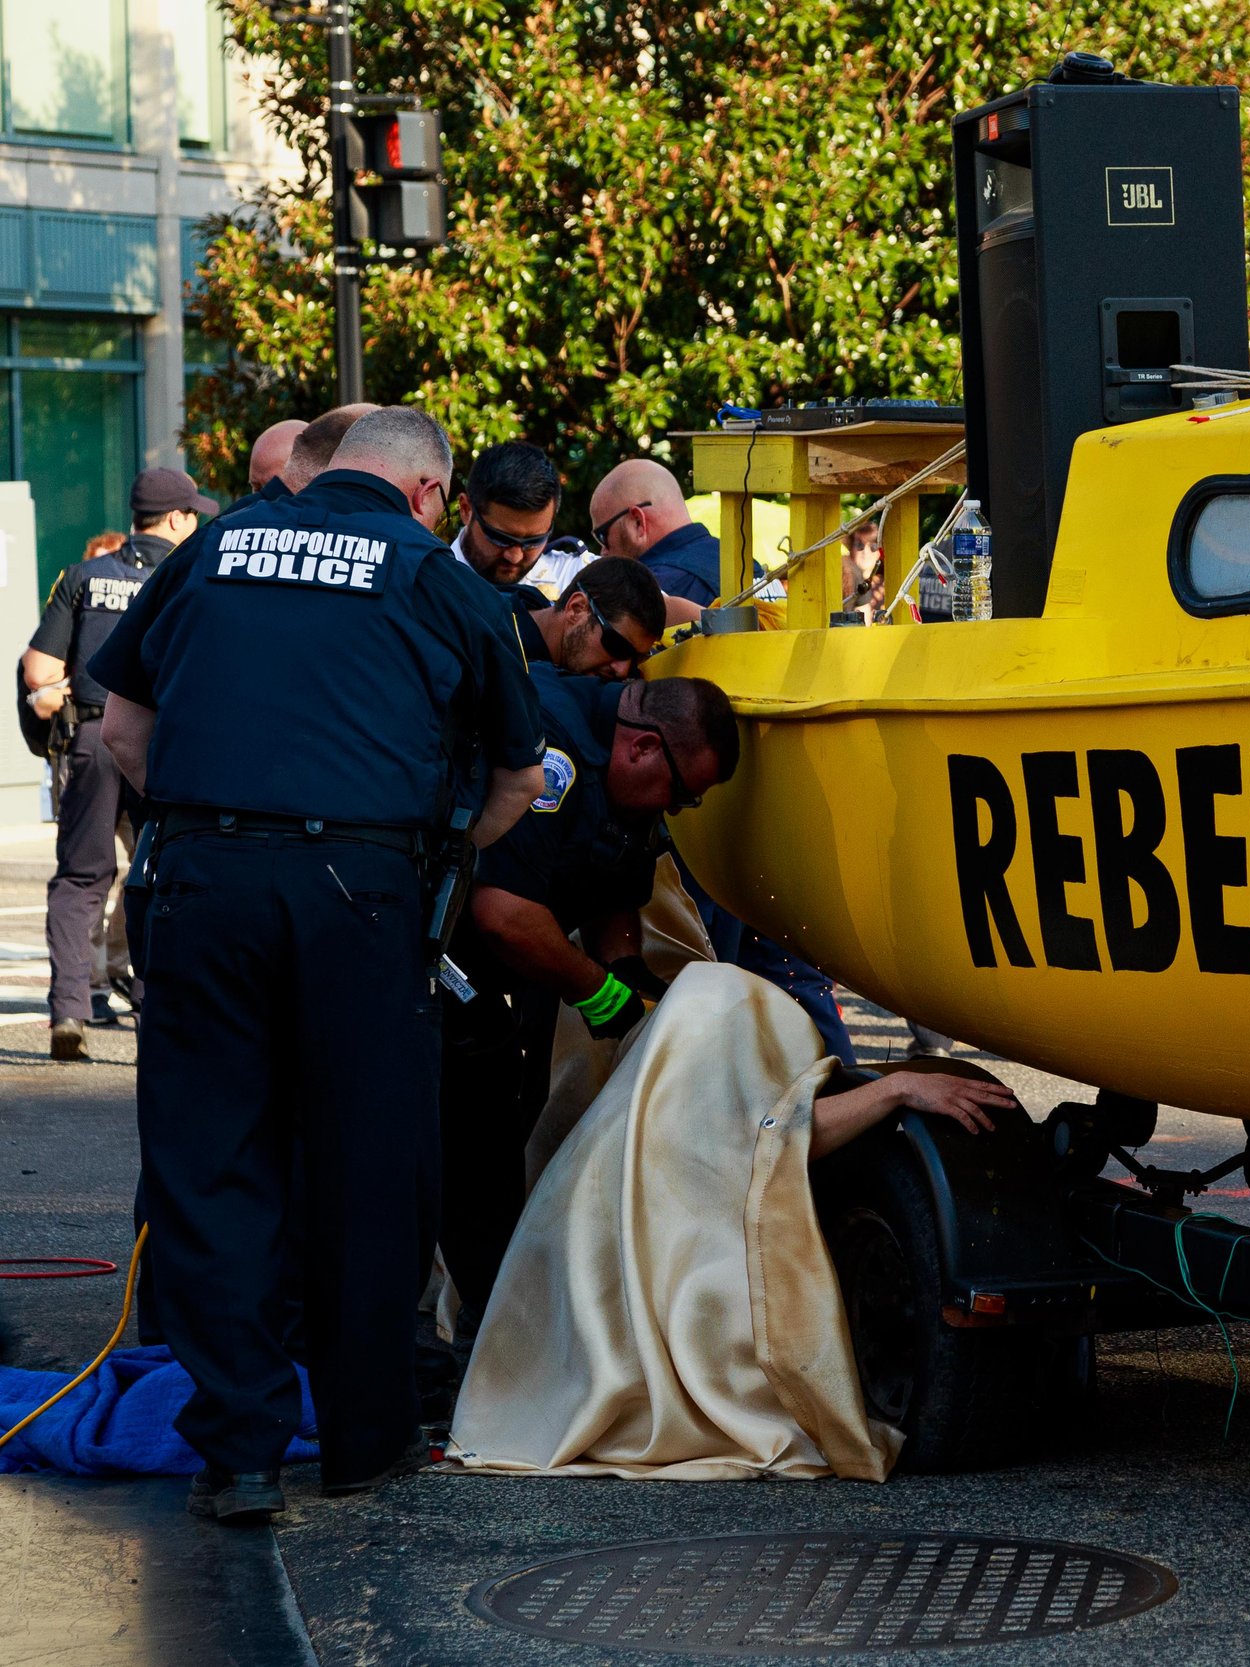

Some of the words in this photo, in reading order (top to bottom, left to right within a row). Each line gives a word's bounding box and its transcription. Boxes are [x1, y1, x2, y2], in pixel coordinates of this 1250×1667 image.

[1122, 183, 1163, 209] JBL
[218, 528, 388, 565] METROPOLITAN
[217, 552, 376, 589] POLICE
[89, 577, 143, 597] METROPO
[90, 592, 129, 611] POL
[923, 593, 952, 610] ICE
[443, 967, 468, 996] INVICTA
